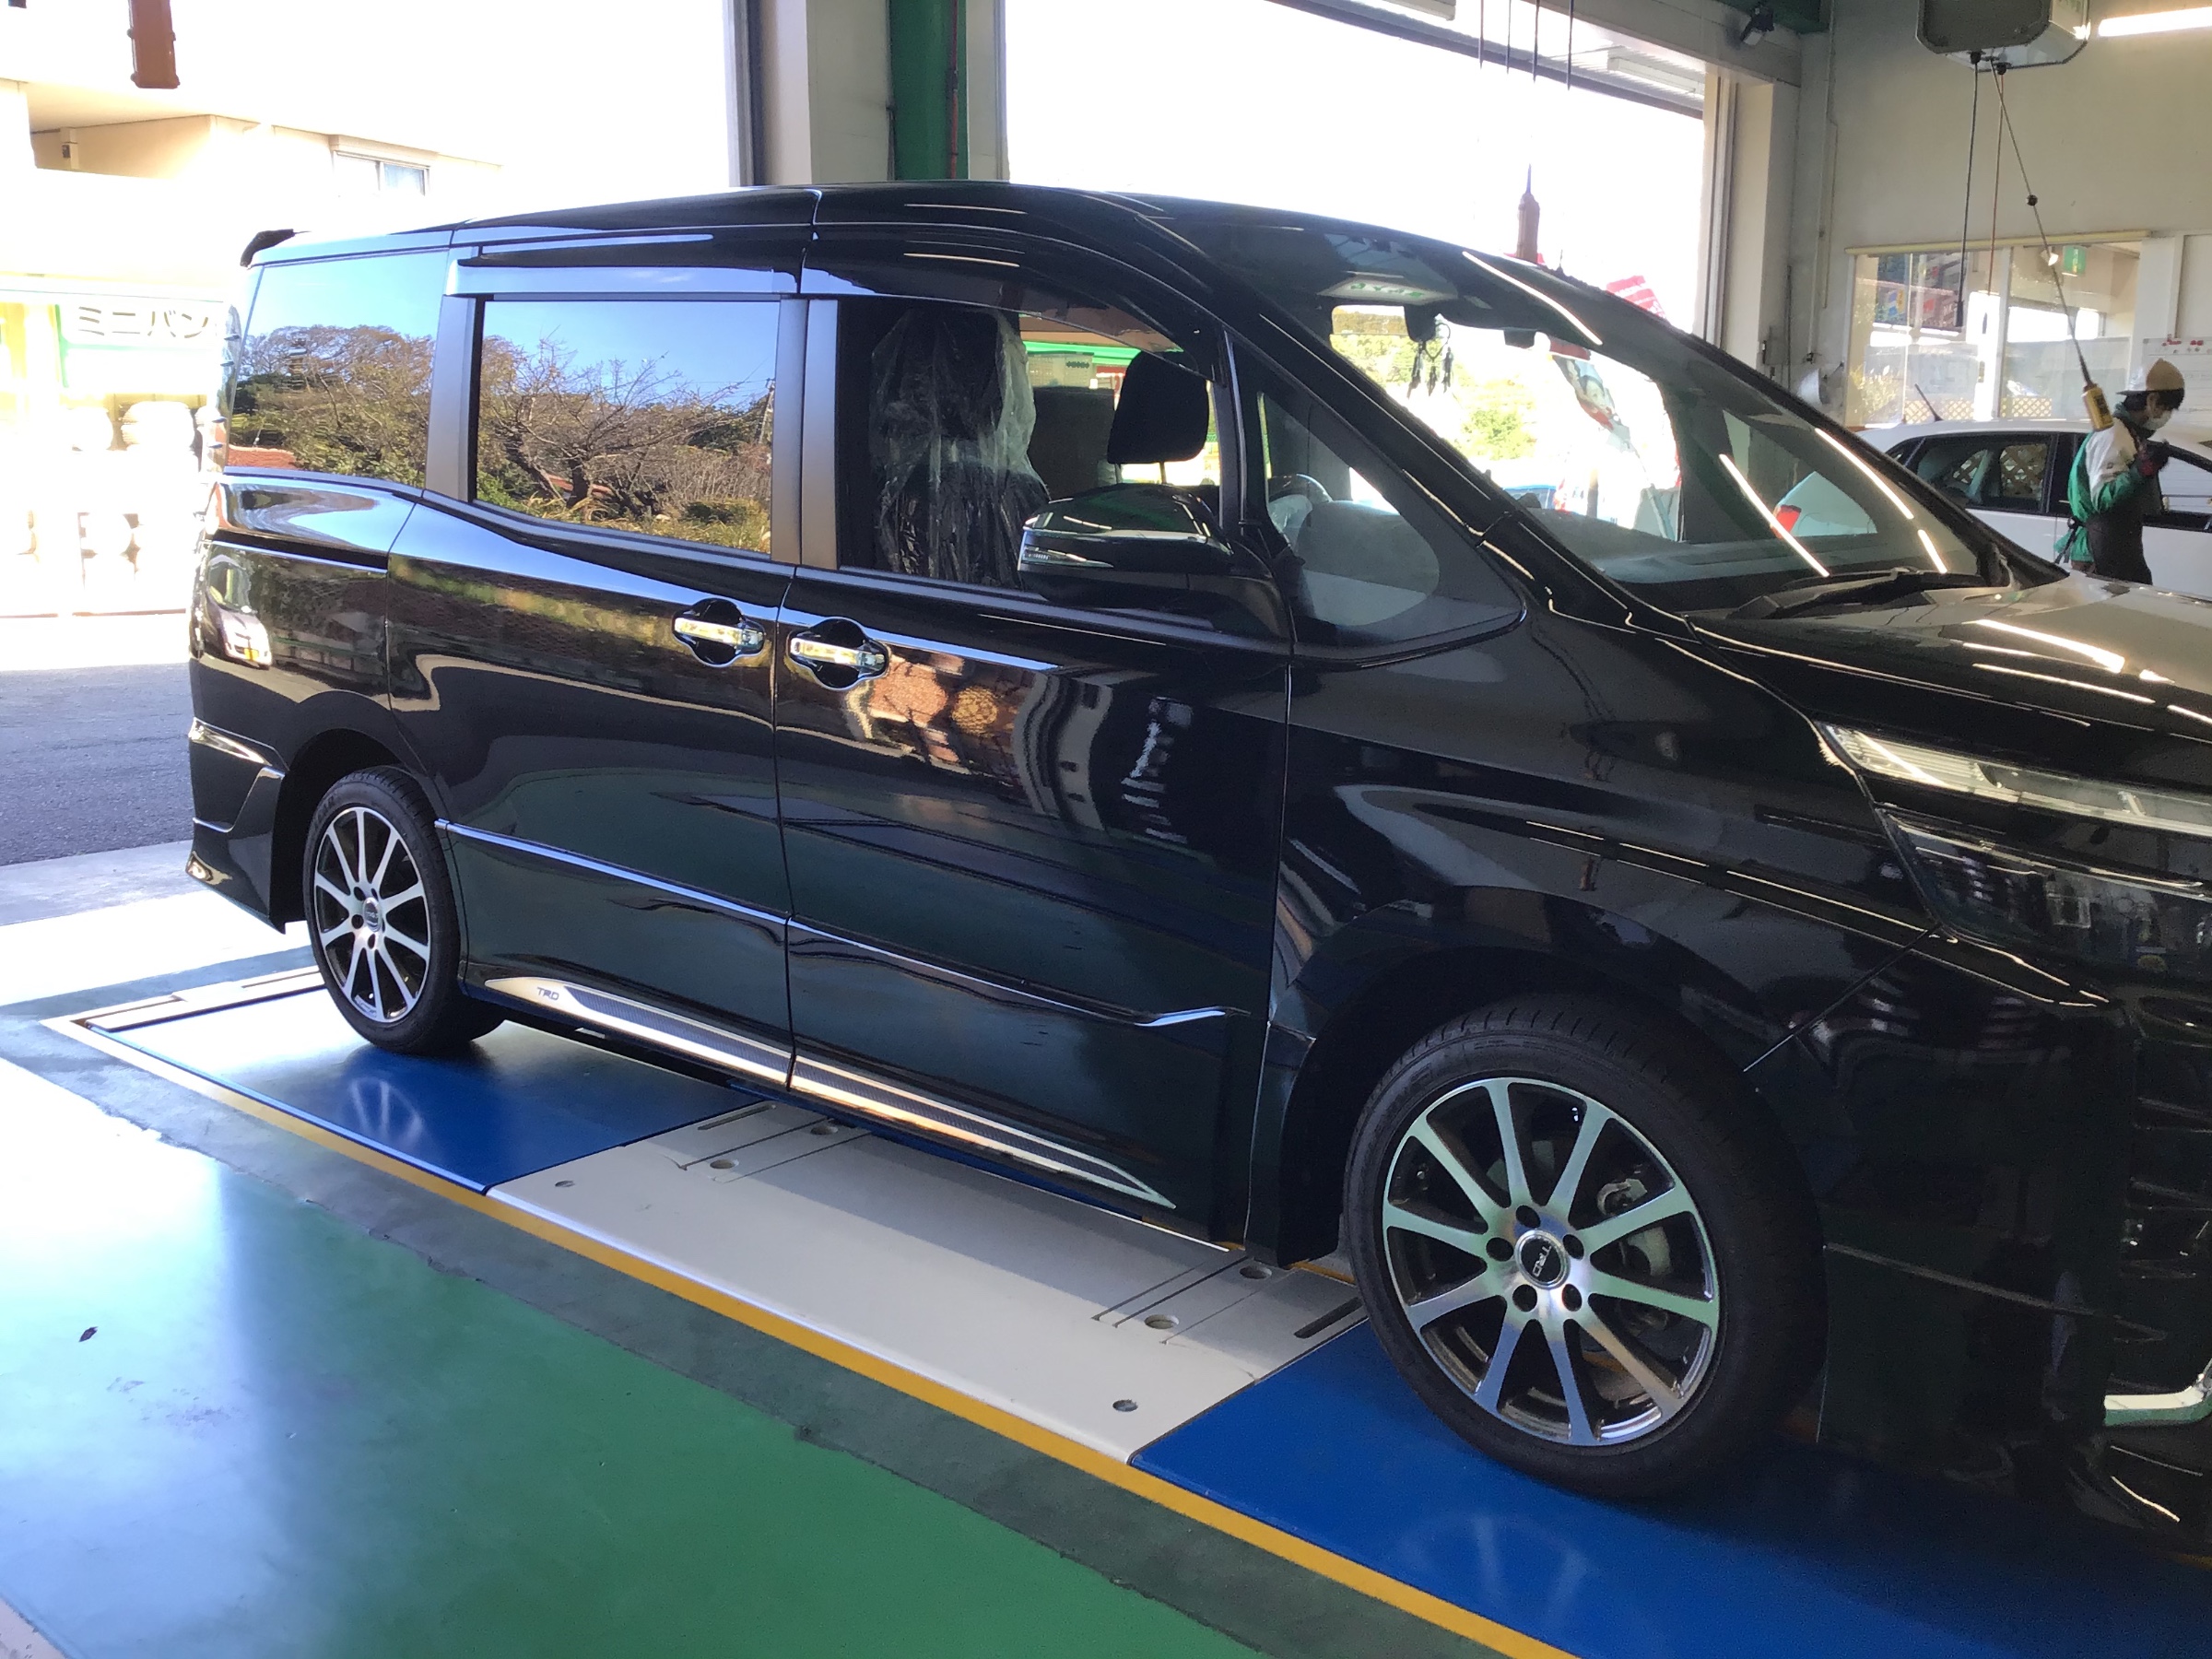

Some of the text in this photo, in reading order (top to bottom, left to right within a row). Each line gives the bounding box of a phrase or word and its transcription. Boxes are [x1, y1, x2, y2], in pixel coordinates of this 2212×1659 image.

[78, 306, 208, 339] ミニバン
[536, 986, 559, 1001] TRD
[1532, 1245, 1552, 1277] TRD
